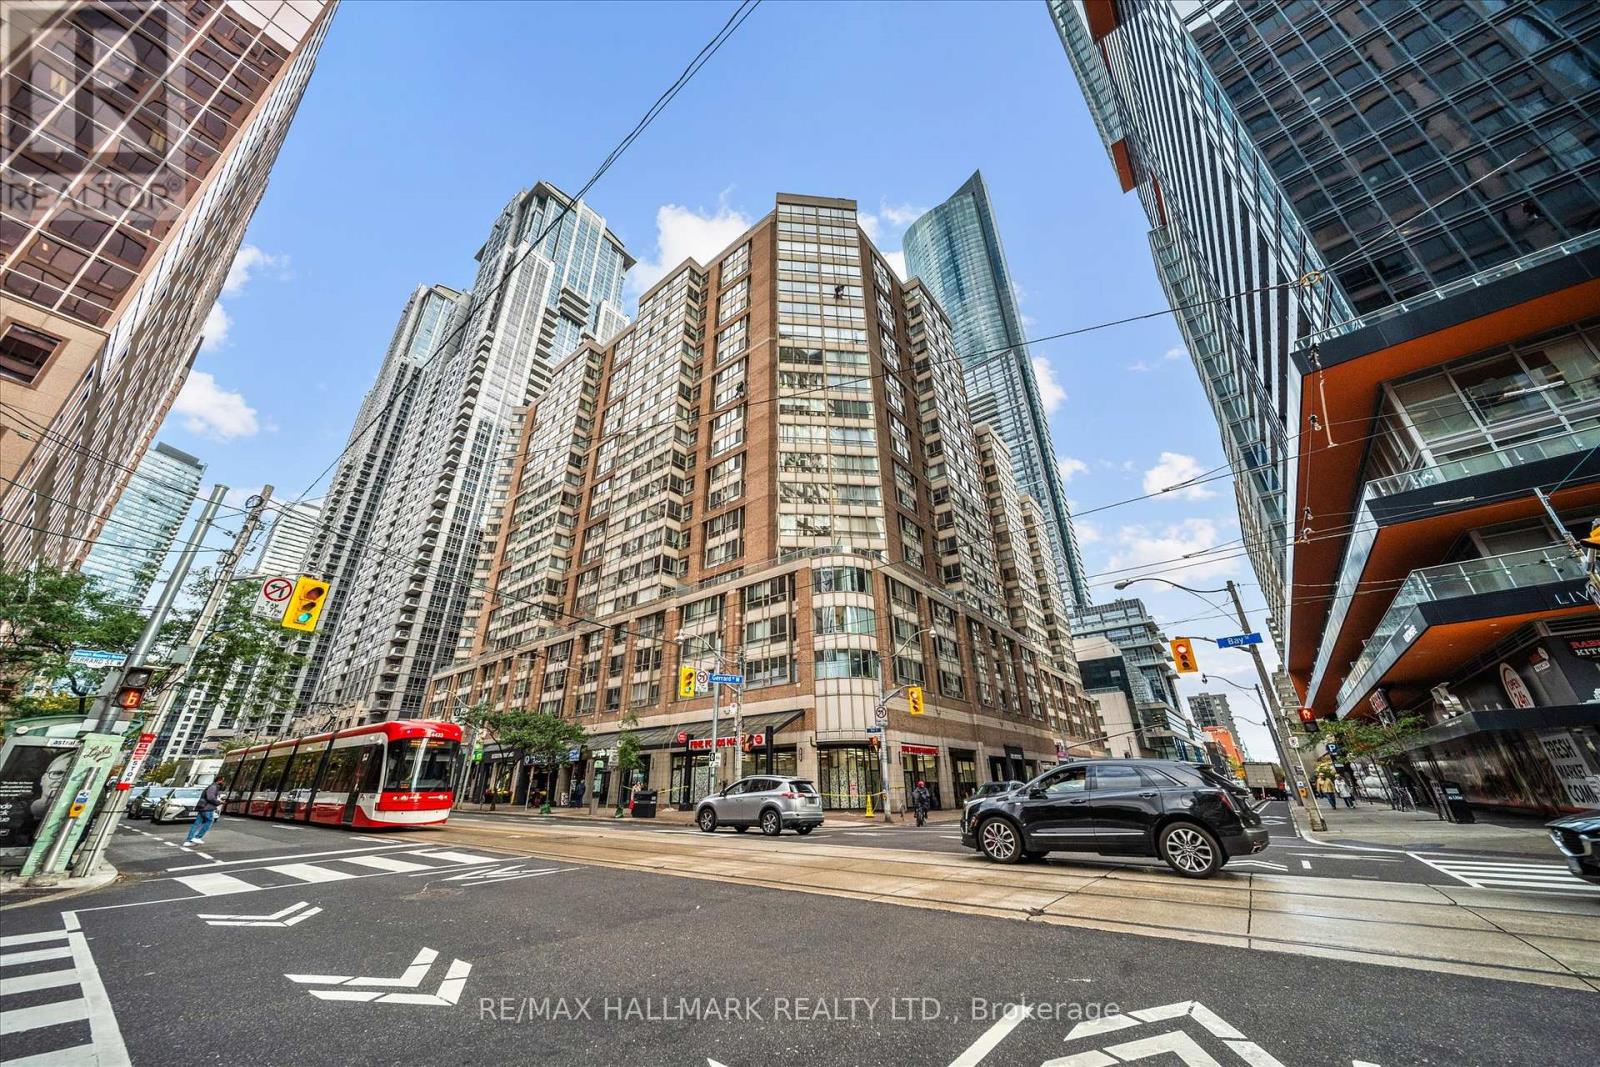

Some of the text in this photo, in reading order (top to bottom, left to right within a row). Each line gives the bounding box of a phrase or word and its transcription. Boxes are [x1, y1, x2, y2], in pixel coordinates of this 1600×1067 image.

[1227, 637, 1244, 645] Bay
[70, 656, 104, 665] GERRARD
[711, 674, 732, 682] Gerrard
[126, 691, 138, 706] 6
[705, 738, 725, 748] FODS
[1543, 738, 1577, 759] FRESH
[125, 760, 139, 782] STOP
